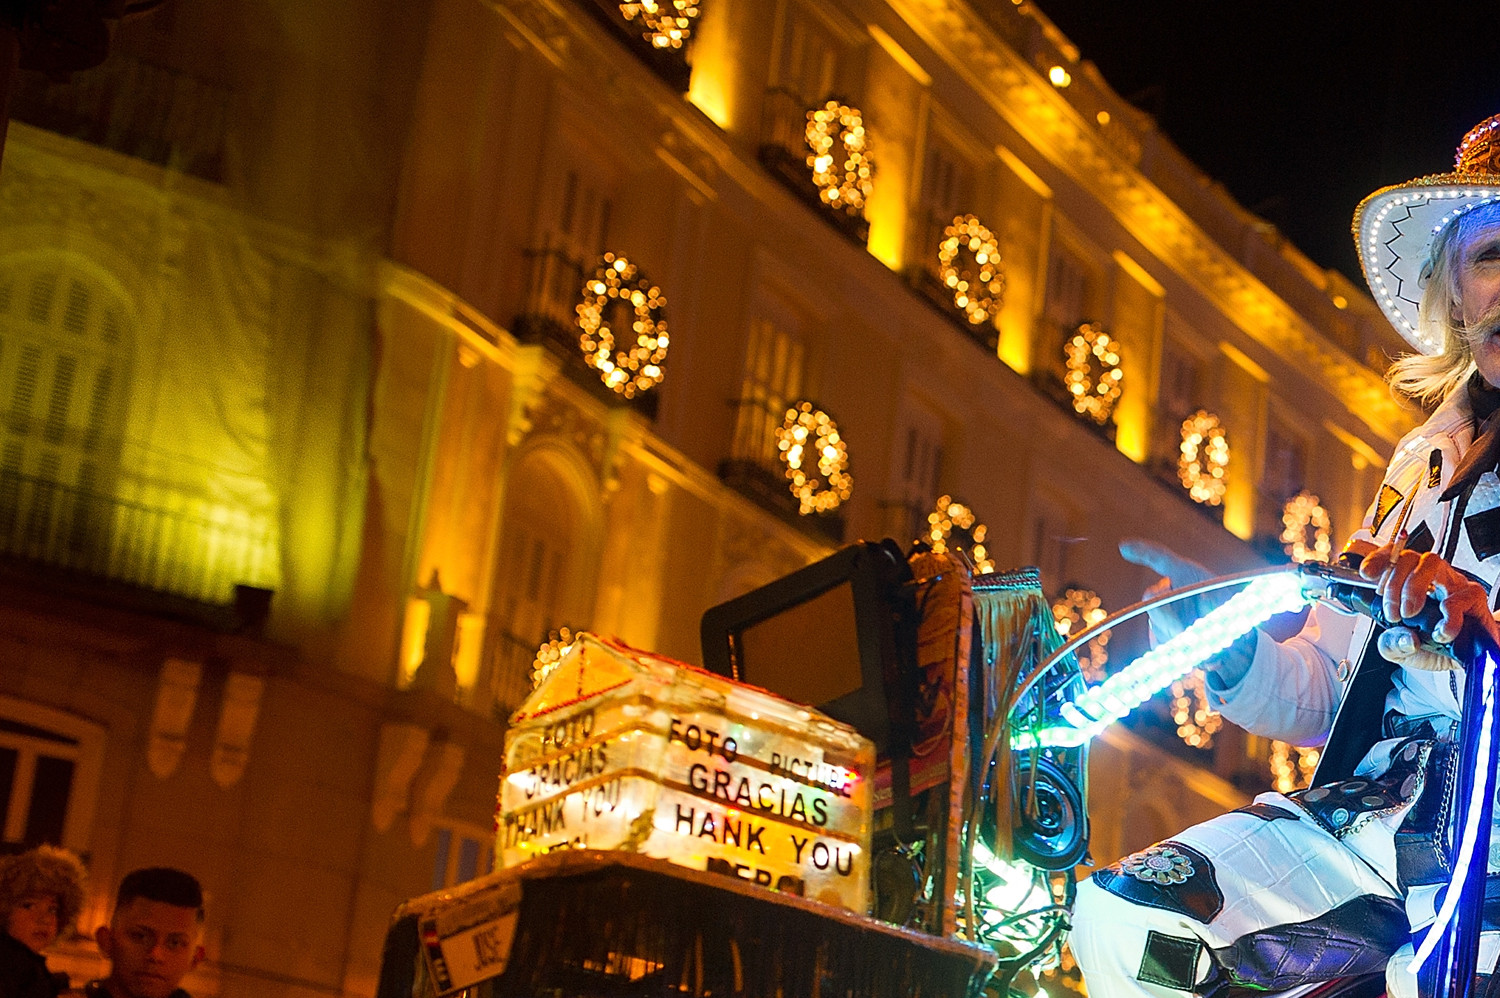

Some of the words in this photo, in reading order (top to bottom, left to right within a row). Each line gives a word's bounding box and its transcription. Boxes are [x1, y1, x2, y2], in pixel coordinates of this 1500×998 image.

[525, 742, 607, 800] GRACIAS
[669, 718, 738, 763] FOTO
[689, 763, 829, 827] GRACIAS
[676, 803, 766, 856] HANK
[791, 834, 853, 877] YOU
